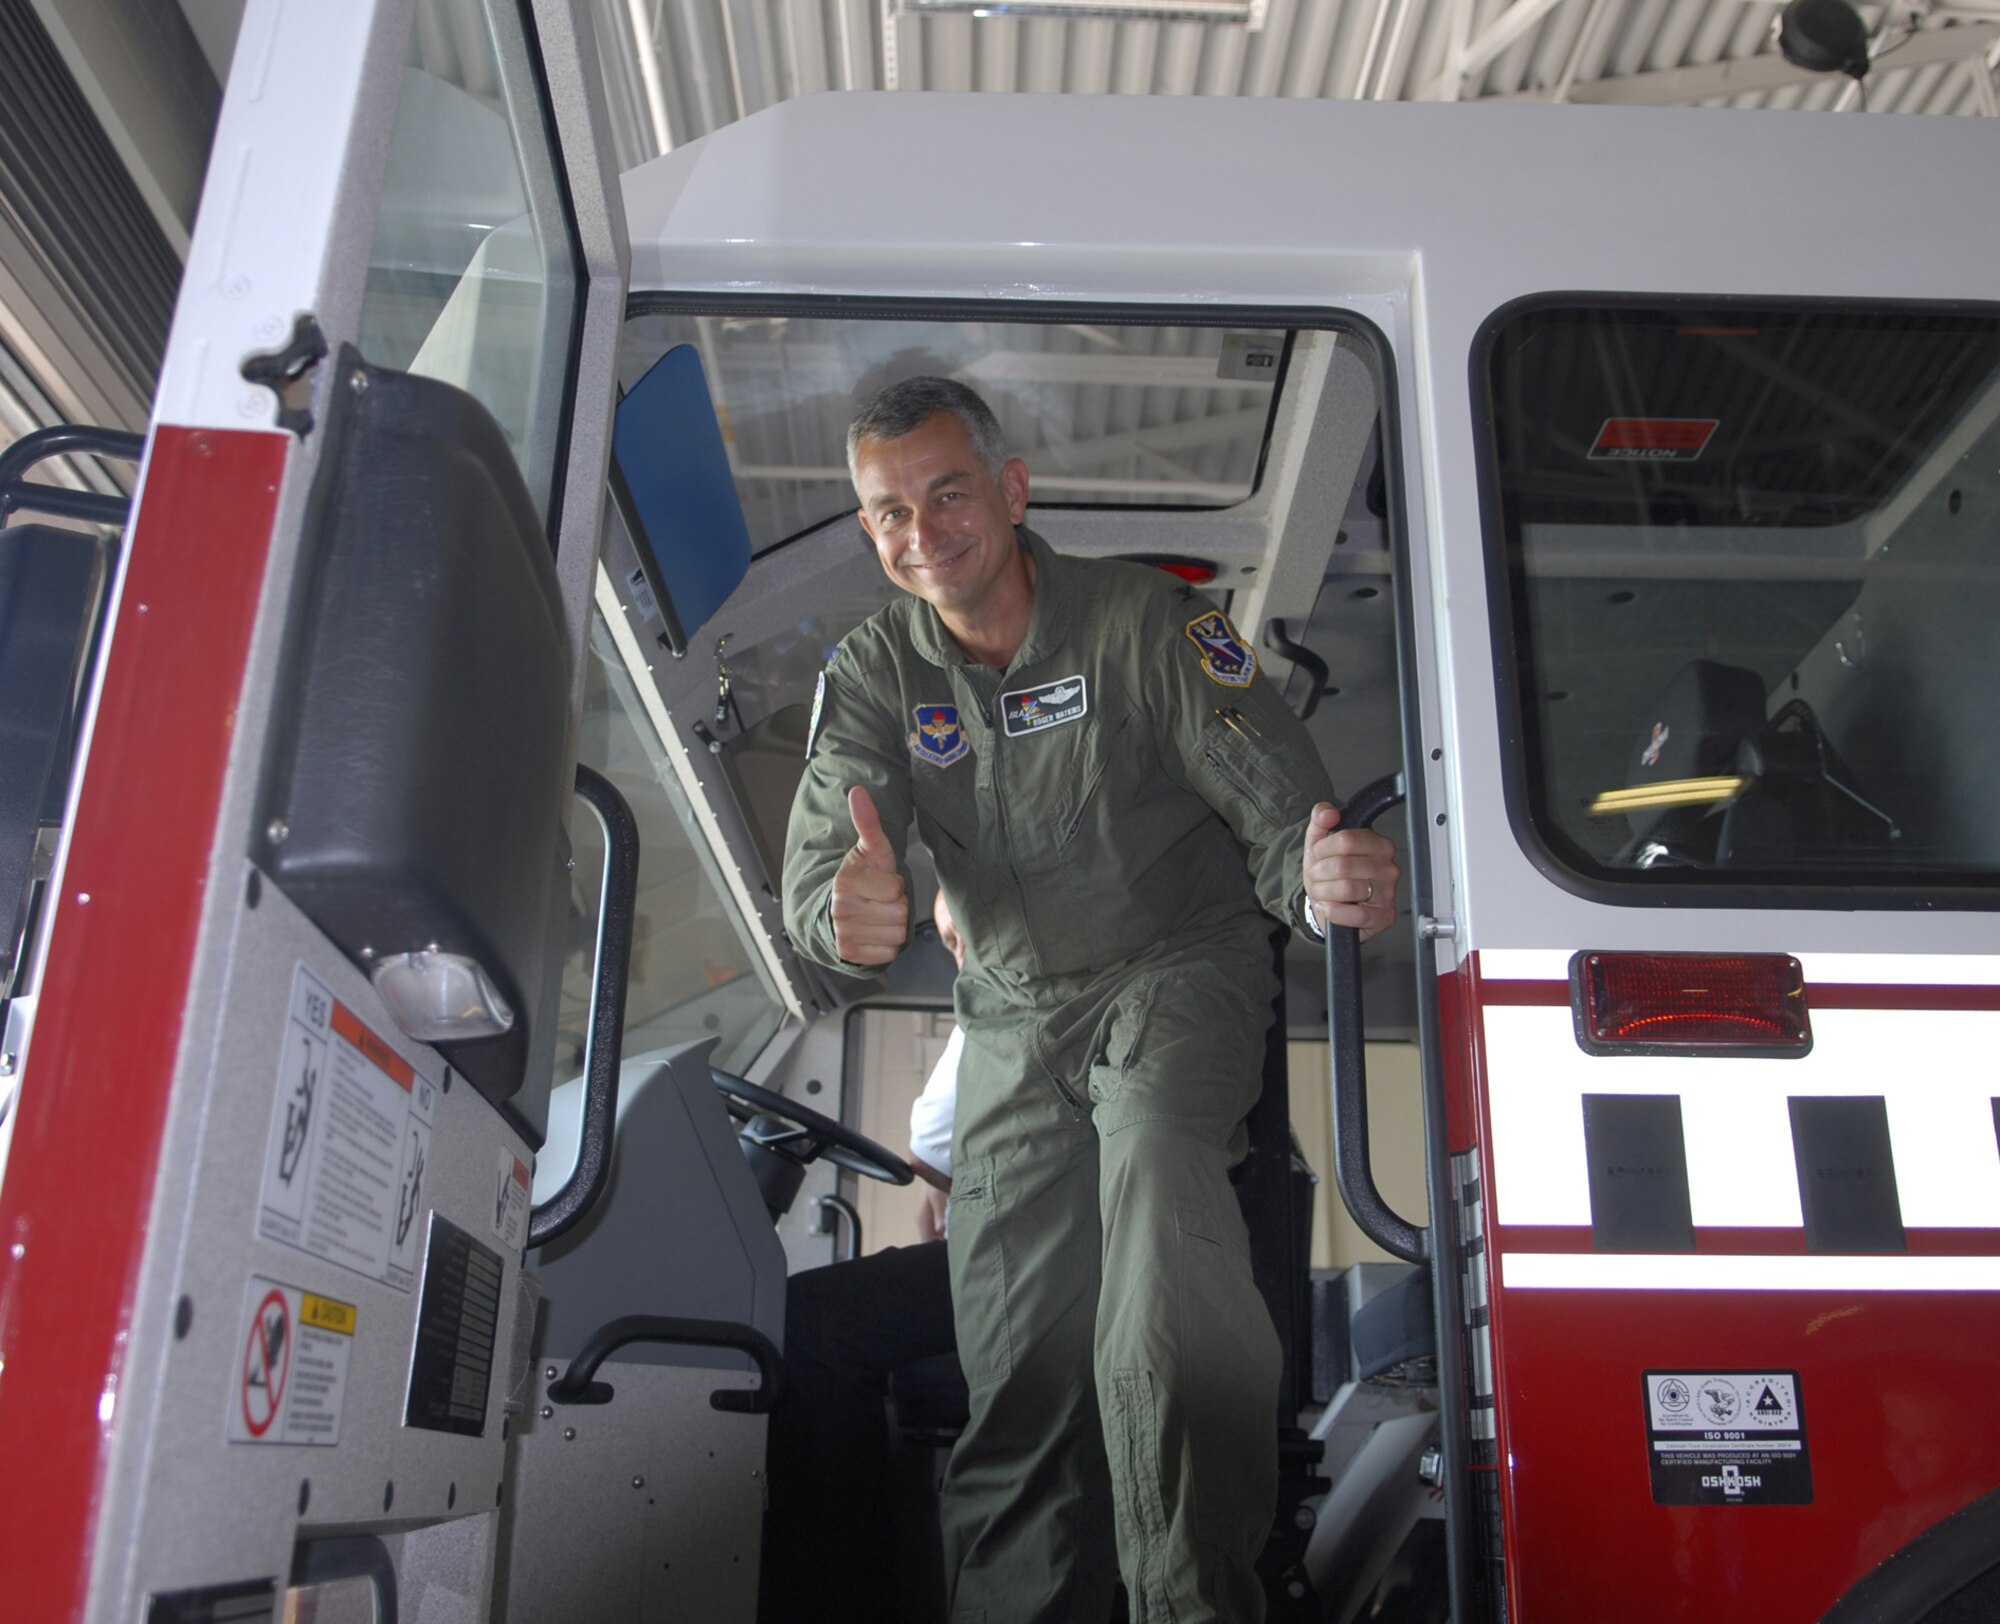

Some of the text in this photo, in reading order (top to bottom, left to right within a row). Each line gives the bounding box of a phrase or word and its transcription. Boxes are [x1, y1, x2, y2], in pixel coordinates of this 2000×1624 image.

[1607, 447, 1678, 458] NOTICE
[1033, 705, 1082, 727] ROGER WATKINS
[305, 988, 325, 1029] YES
[418, 1082, 432, 1113] NO
[1704, 1432, 1745, 1440] ISO 9001
[1701, 1476, 1761, 1488] OSHKOSH
